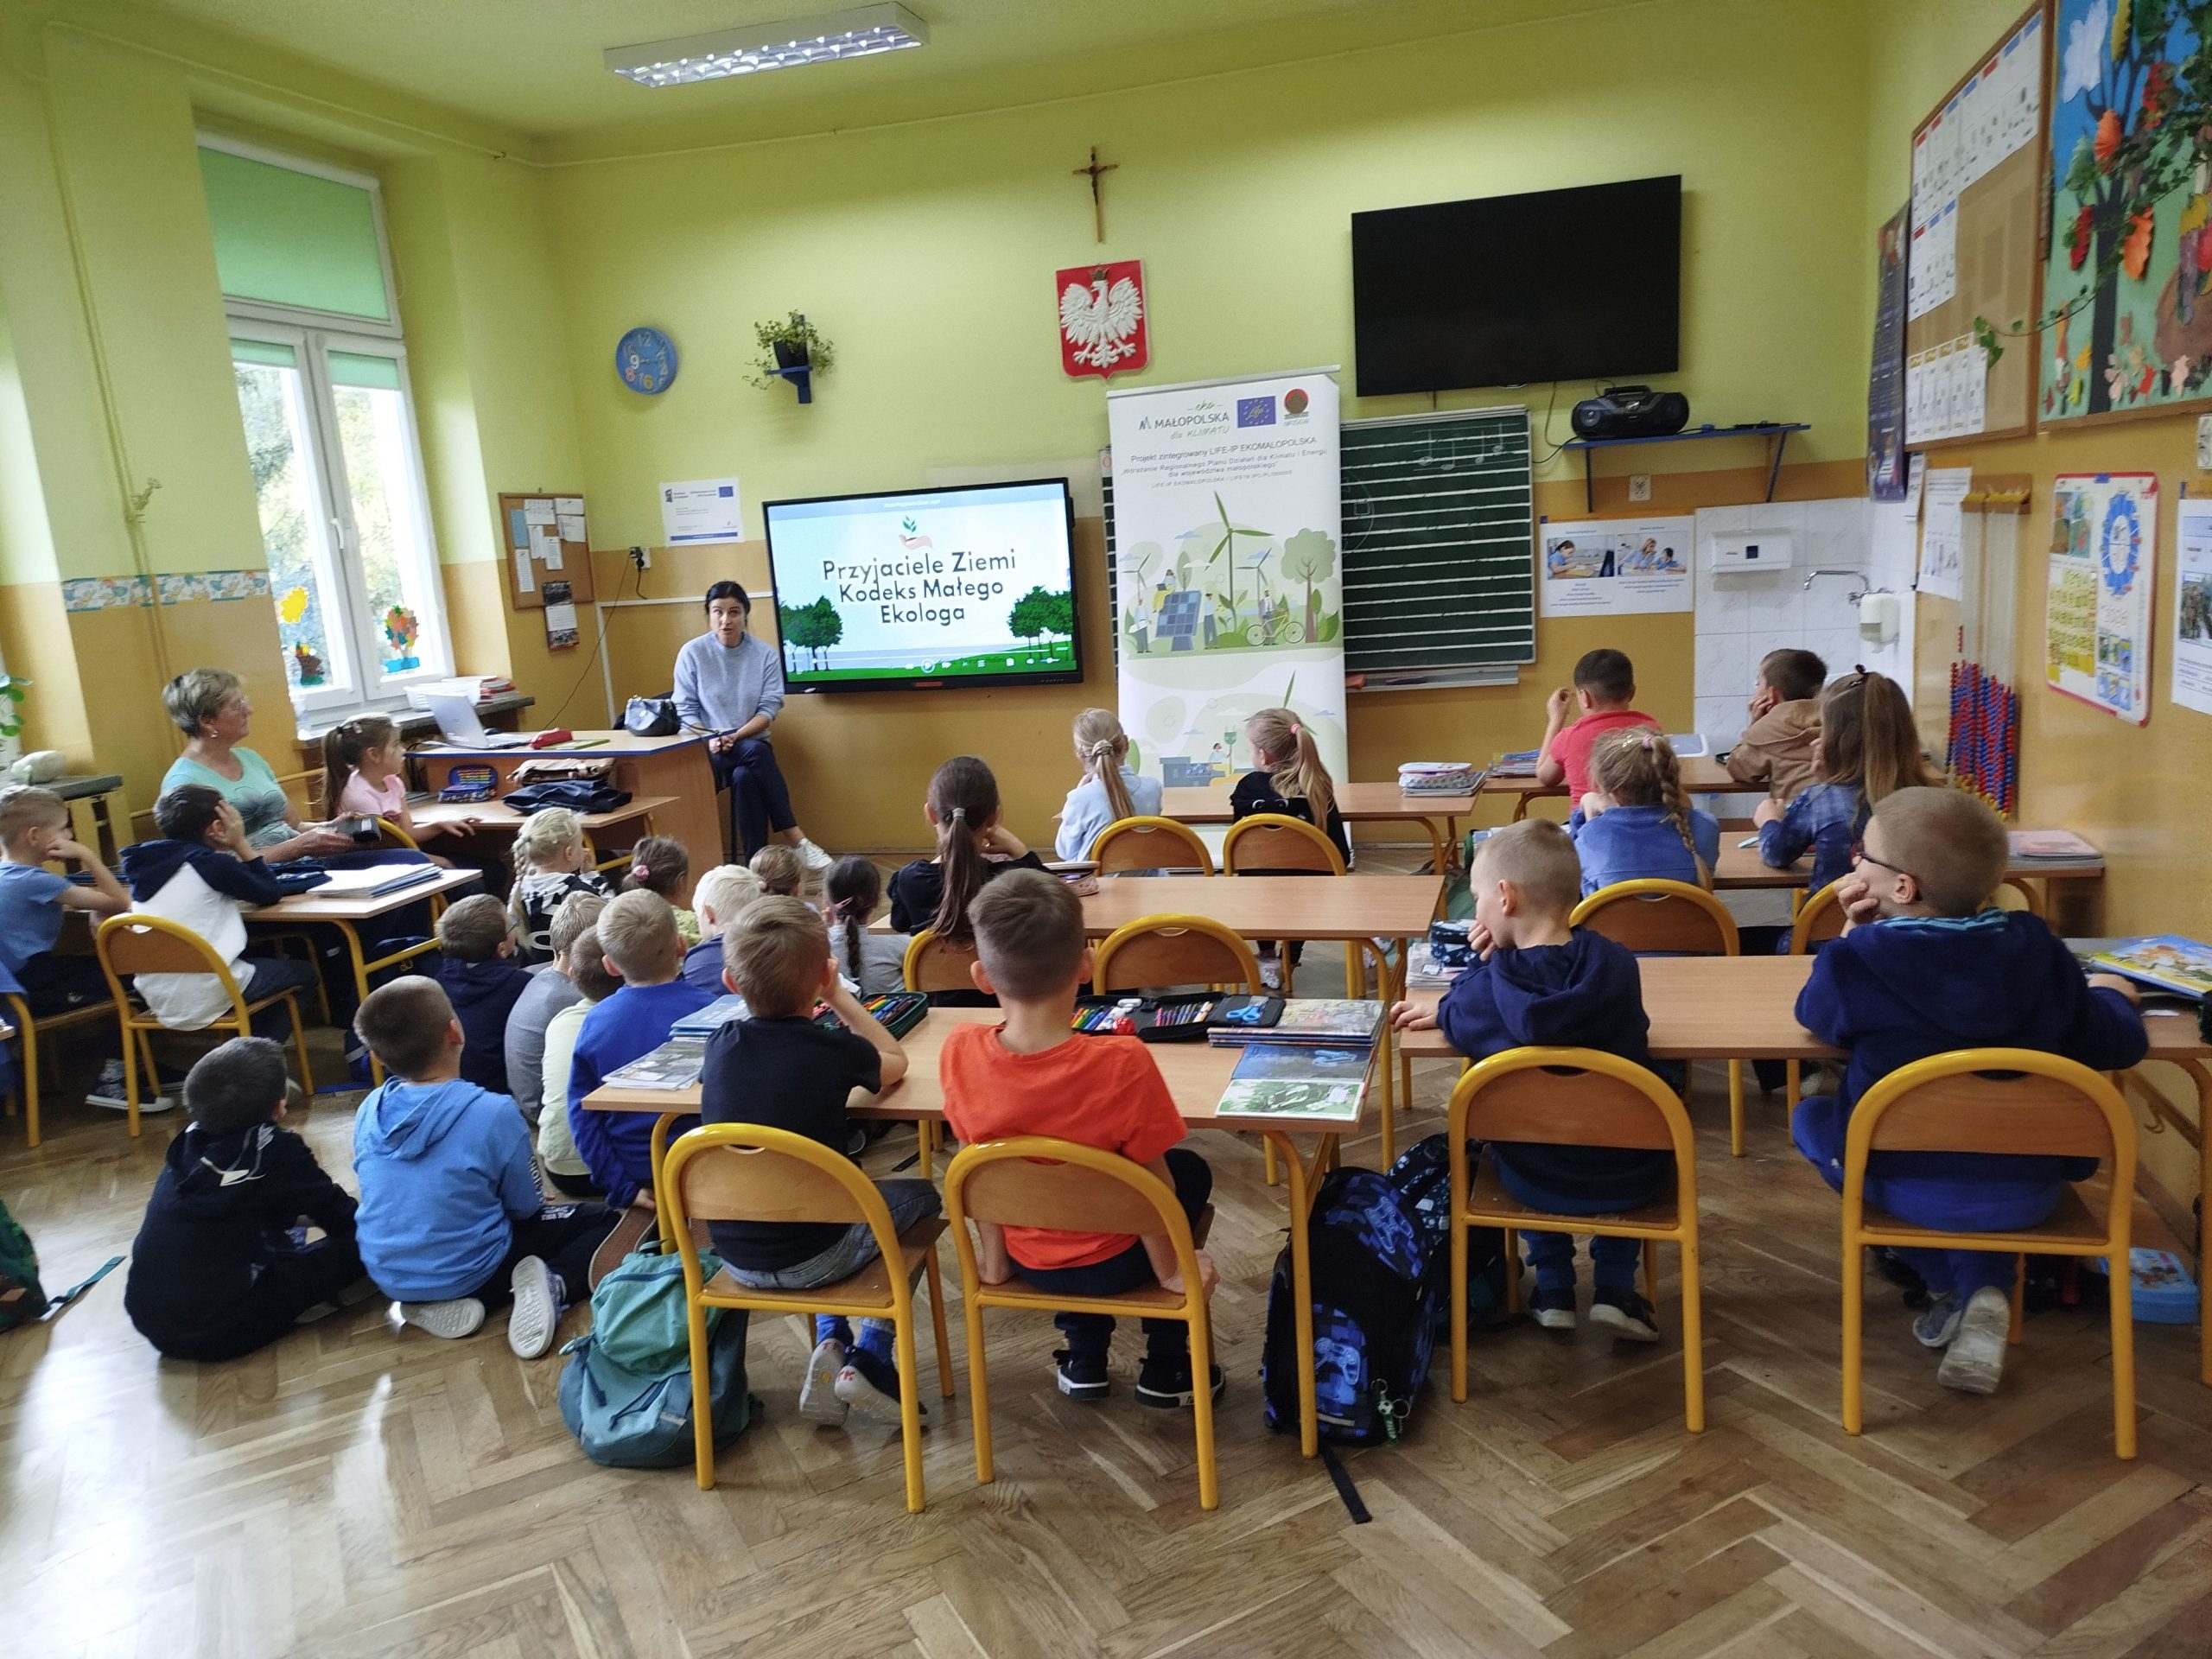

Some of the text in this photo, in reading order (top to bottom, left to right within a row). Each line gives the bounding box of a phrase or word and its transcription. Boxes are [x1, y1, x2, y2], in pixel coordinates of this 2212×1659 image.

[630, 354, 639, 370] 9
[625, 365, 636, 382] 8
[643, 373, 654, 390] 6
[1154, 411, 1230, 429] MAŁOPOLSKA
[1187, 425, 1230, 437] KLIMATU
[1130, 454, 1158, 463] Projekt
[1159, 448, 1209, 461] zintegrowany
[1209, 443, 1239, 455] LIFE-IP
[1160, 462, 1206, 472] Regionalnego
[1269, 451, 1296, 460] Klimatu
[823, 549, 1017, 584] Przyjaciele Ziemi
[839, 576, 1004, 603] Kodeks Małego
[880, 602, 965, 626] Ekologa
